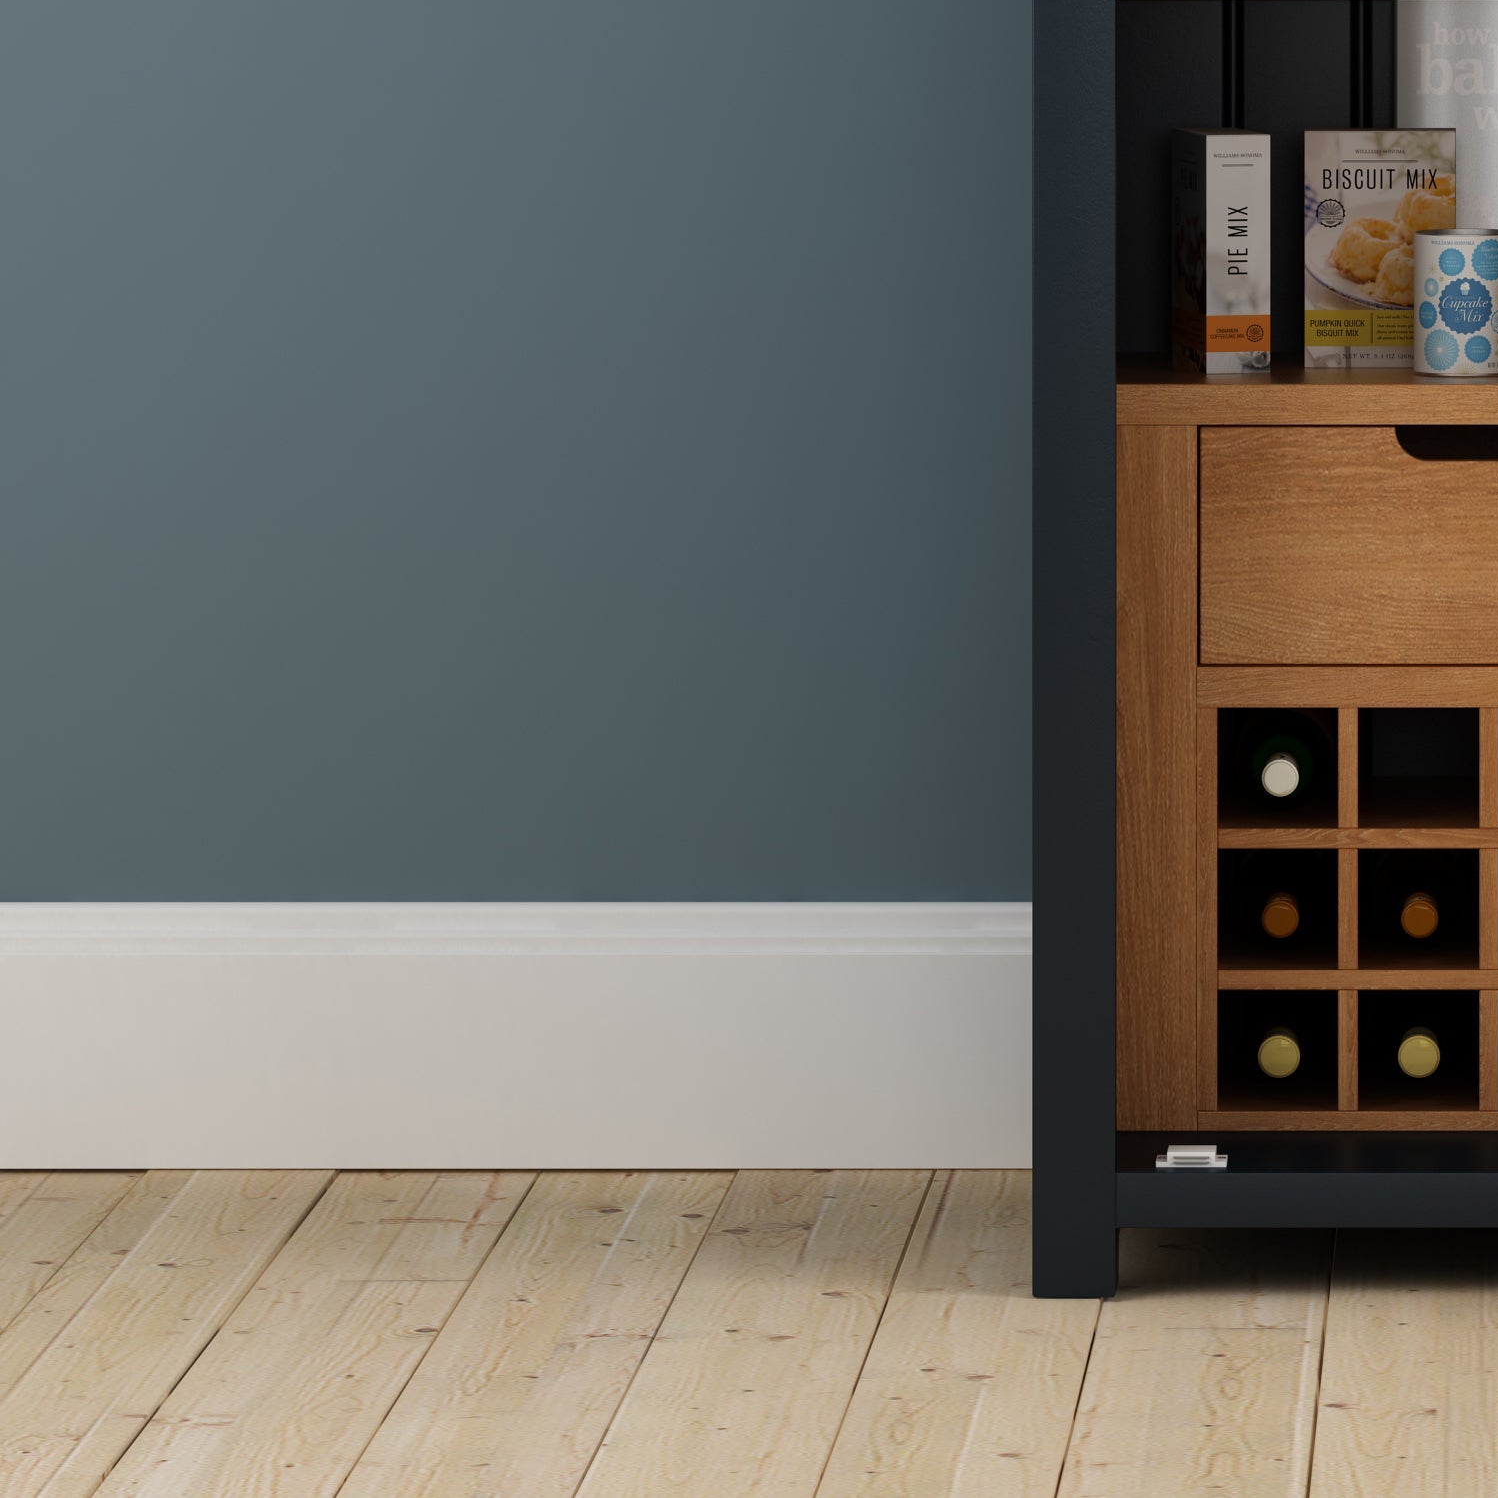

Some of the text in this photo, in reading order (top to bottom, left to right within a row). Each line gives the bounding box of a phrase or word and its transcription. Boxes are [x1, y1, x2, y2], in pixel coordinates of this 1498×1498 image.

[1433, 22, 1490, 46] how
[1321, 168, 1438, 190] BISCUIT MIX
[1227, 206, 1249, 276] PIE MIX
[1441, 296, 1489, 312] Cupcake
[1309, 319, 1366, 328] PUMPKIN QUICK
[1455, 308, 1485, 323] Mix
[1316, 328, 1359, 338] BISQUIT MIX
